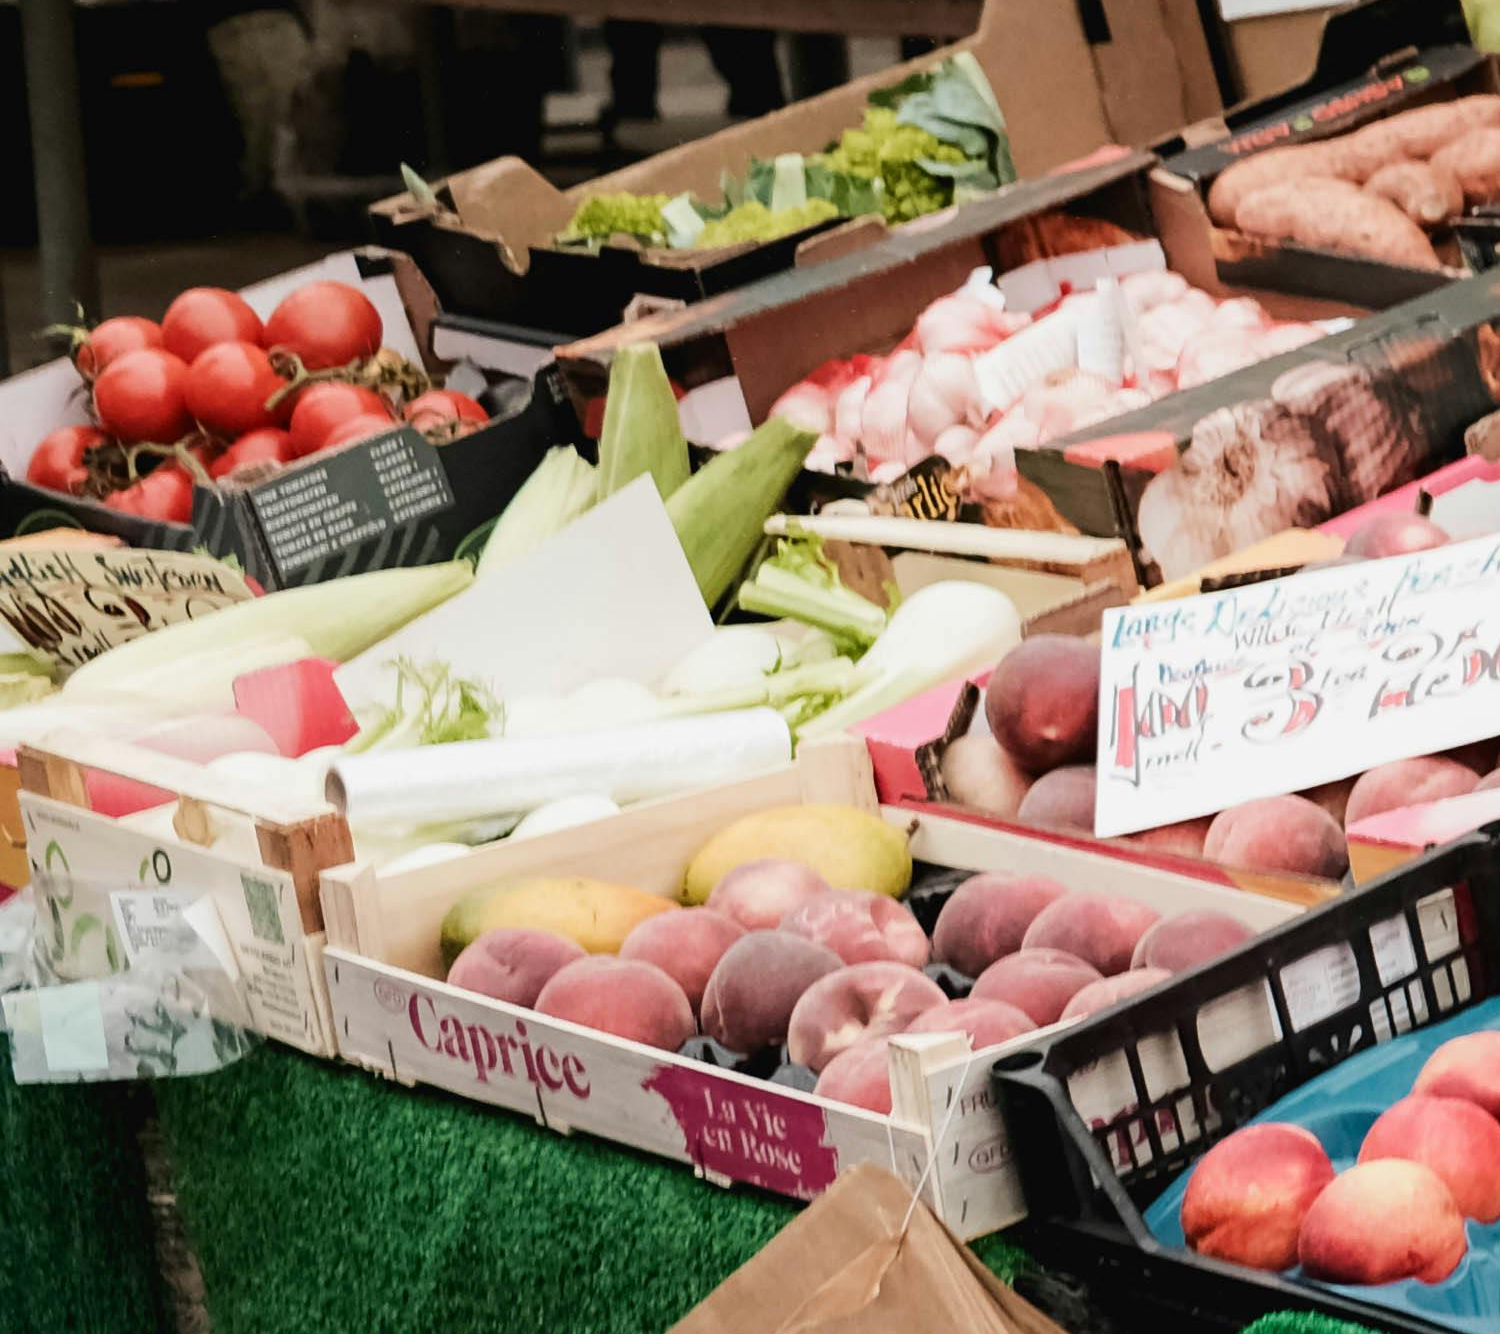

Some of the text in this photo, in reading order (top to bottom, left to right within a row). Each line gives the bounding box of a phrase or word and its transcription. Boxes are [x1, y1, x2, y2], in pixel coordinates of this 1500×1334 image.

[408, 991, 591, 1101] Caprice
[704, 1087, 788, 1140] La Vie
[703, 1123, 804, 1176] en Rose
